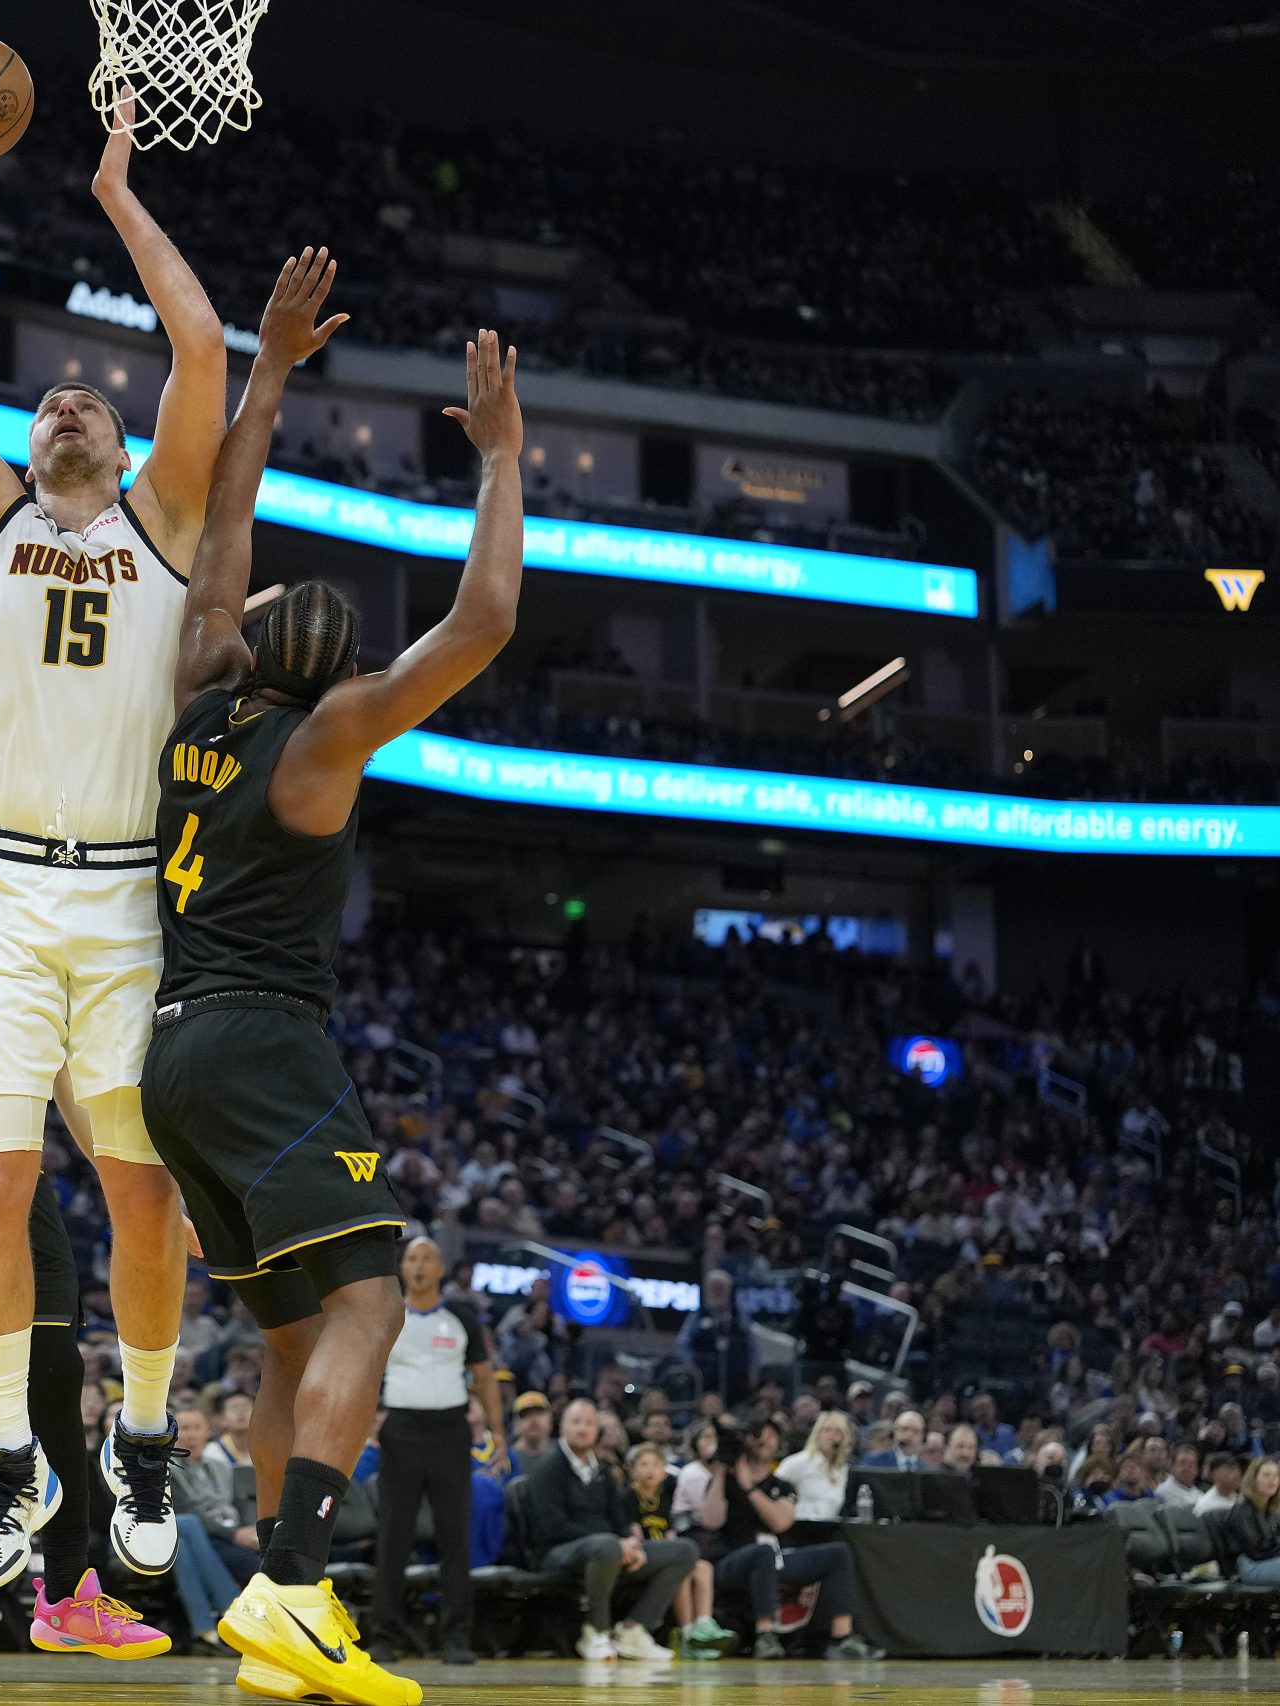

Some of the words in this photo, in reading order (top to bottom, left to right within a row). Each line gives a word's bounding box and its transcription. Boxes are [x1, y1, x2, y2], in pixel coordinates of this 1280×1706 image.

[66, 281, 158, 333] Adobe
[41, 586, 110, 669] 15
[173, 743, 242, 793] MOODY
[495, 759, 613, 804] working
[619, 768, 648, 799] to
[651, 770, 750, 809] deliver
[754, 781, 820, 818] safe,
[825, 788, 936, 829] reliable,
[941, 800, 989, 831] and
[994, 803, 1133, 841] affordable
[1139, 815, 1243, 849] energy.
[164, 812, 205, 914] 4
[471, 1262, 551, 1296] PEPS
